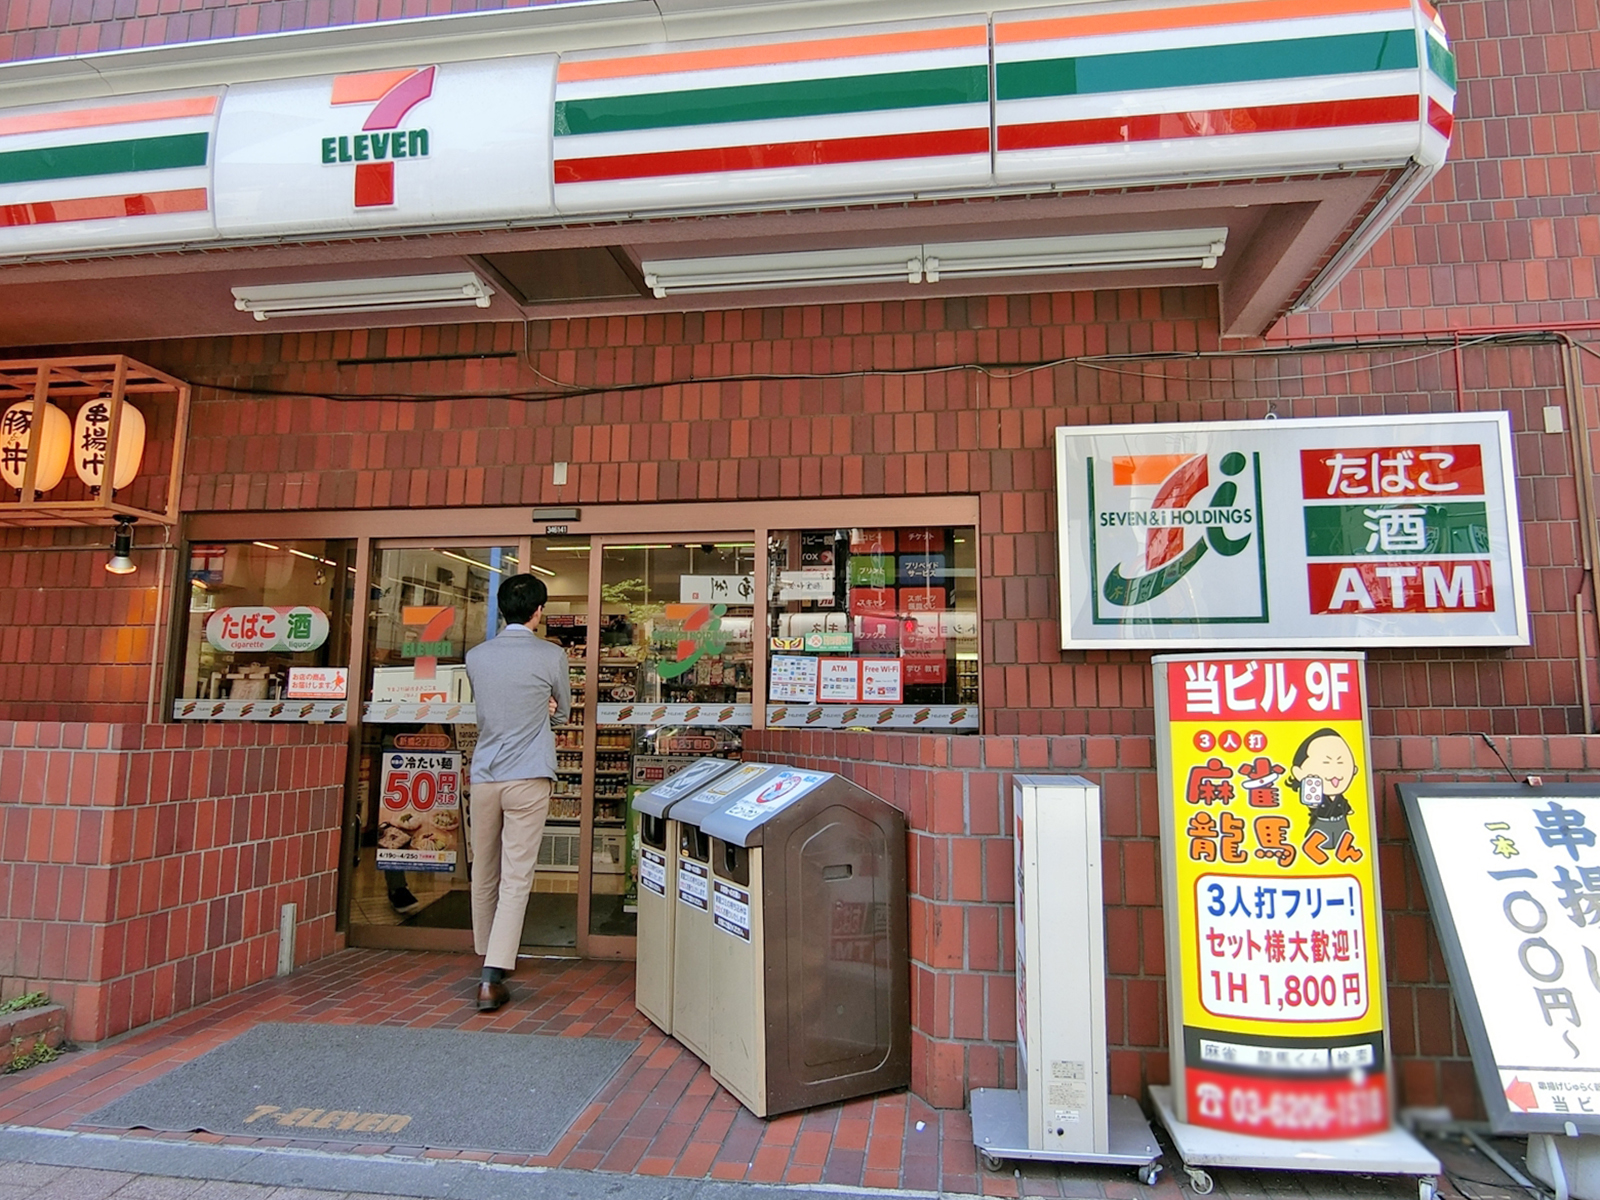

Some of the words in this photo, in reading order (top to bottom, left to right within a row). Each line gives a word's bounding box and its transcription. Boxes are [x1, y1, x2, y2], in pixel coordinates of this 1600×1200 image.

[1326, 450, 1459, 496] たばこ
[1171, 508, 1252, 525] HOLDINGS
[1363, 508, 1427, 553] 酒
[1328, 565, 1477, 610] ATM
[221, 612, 276, 640] たばこ
[286, 612, 312, 640] 酒
[230, 640, 264, 649] cigarette
[288, 640, 311, 649] liquor
[831, 665, 848, 673] ATM
[864, 665, 879, 673] Free
[881, 665, 899, 673] Wi-Fi
[1184, 660, 1297, 715] 当ビル
[1305, 661, 1350, 711] 9F
[1197, 733, 1264, 750] 3人打
[404, 756, 453, 769] 冷たい麺
[1187, 757, 1287, 808] 麻雀
[1187, 811, 1364, 867] 龍馬くん
[1210, 970, 1248, 1004] 1H
[1259, 973, 1361, 1012] 1,800円
